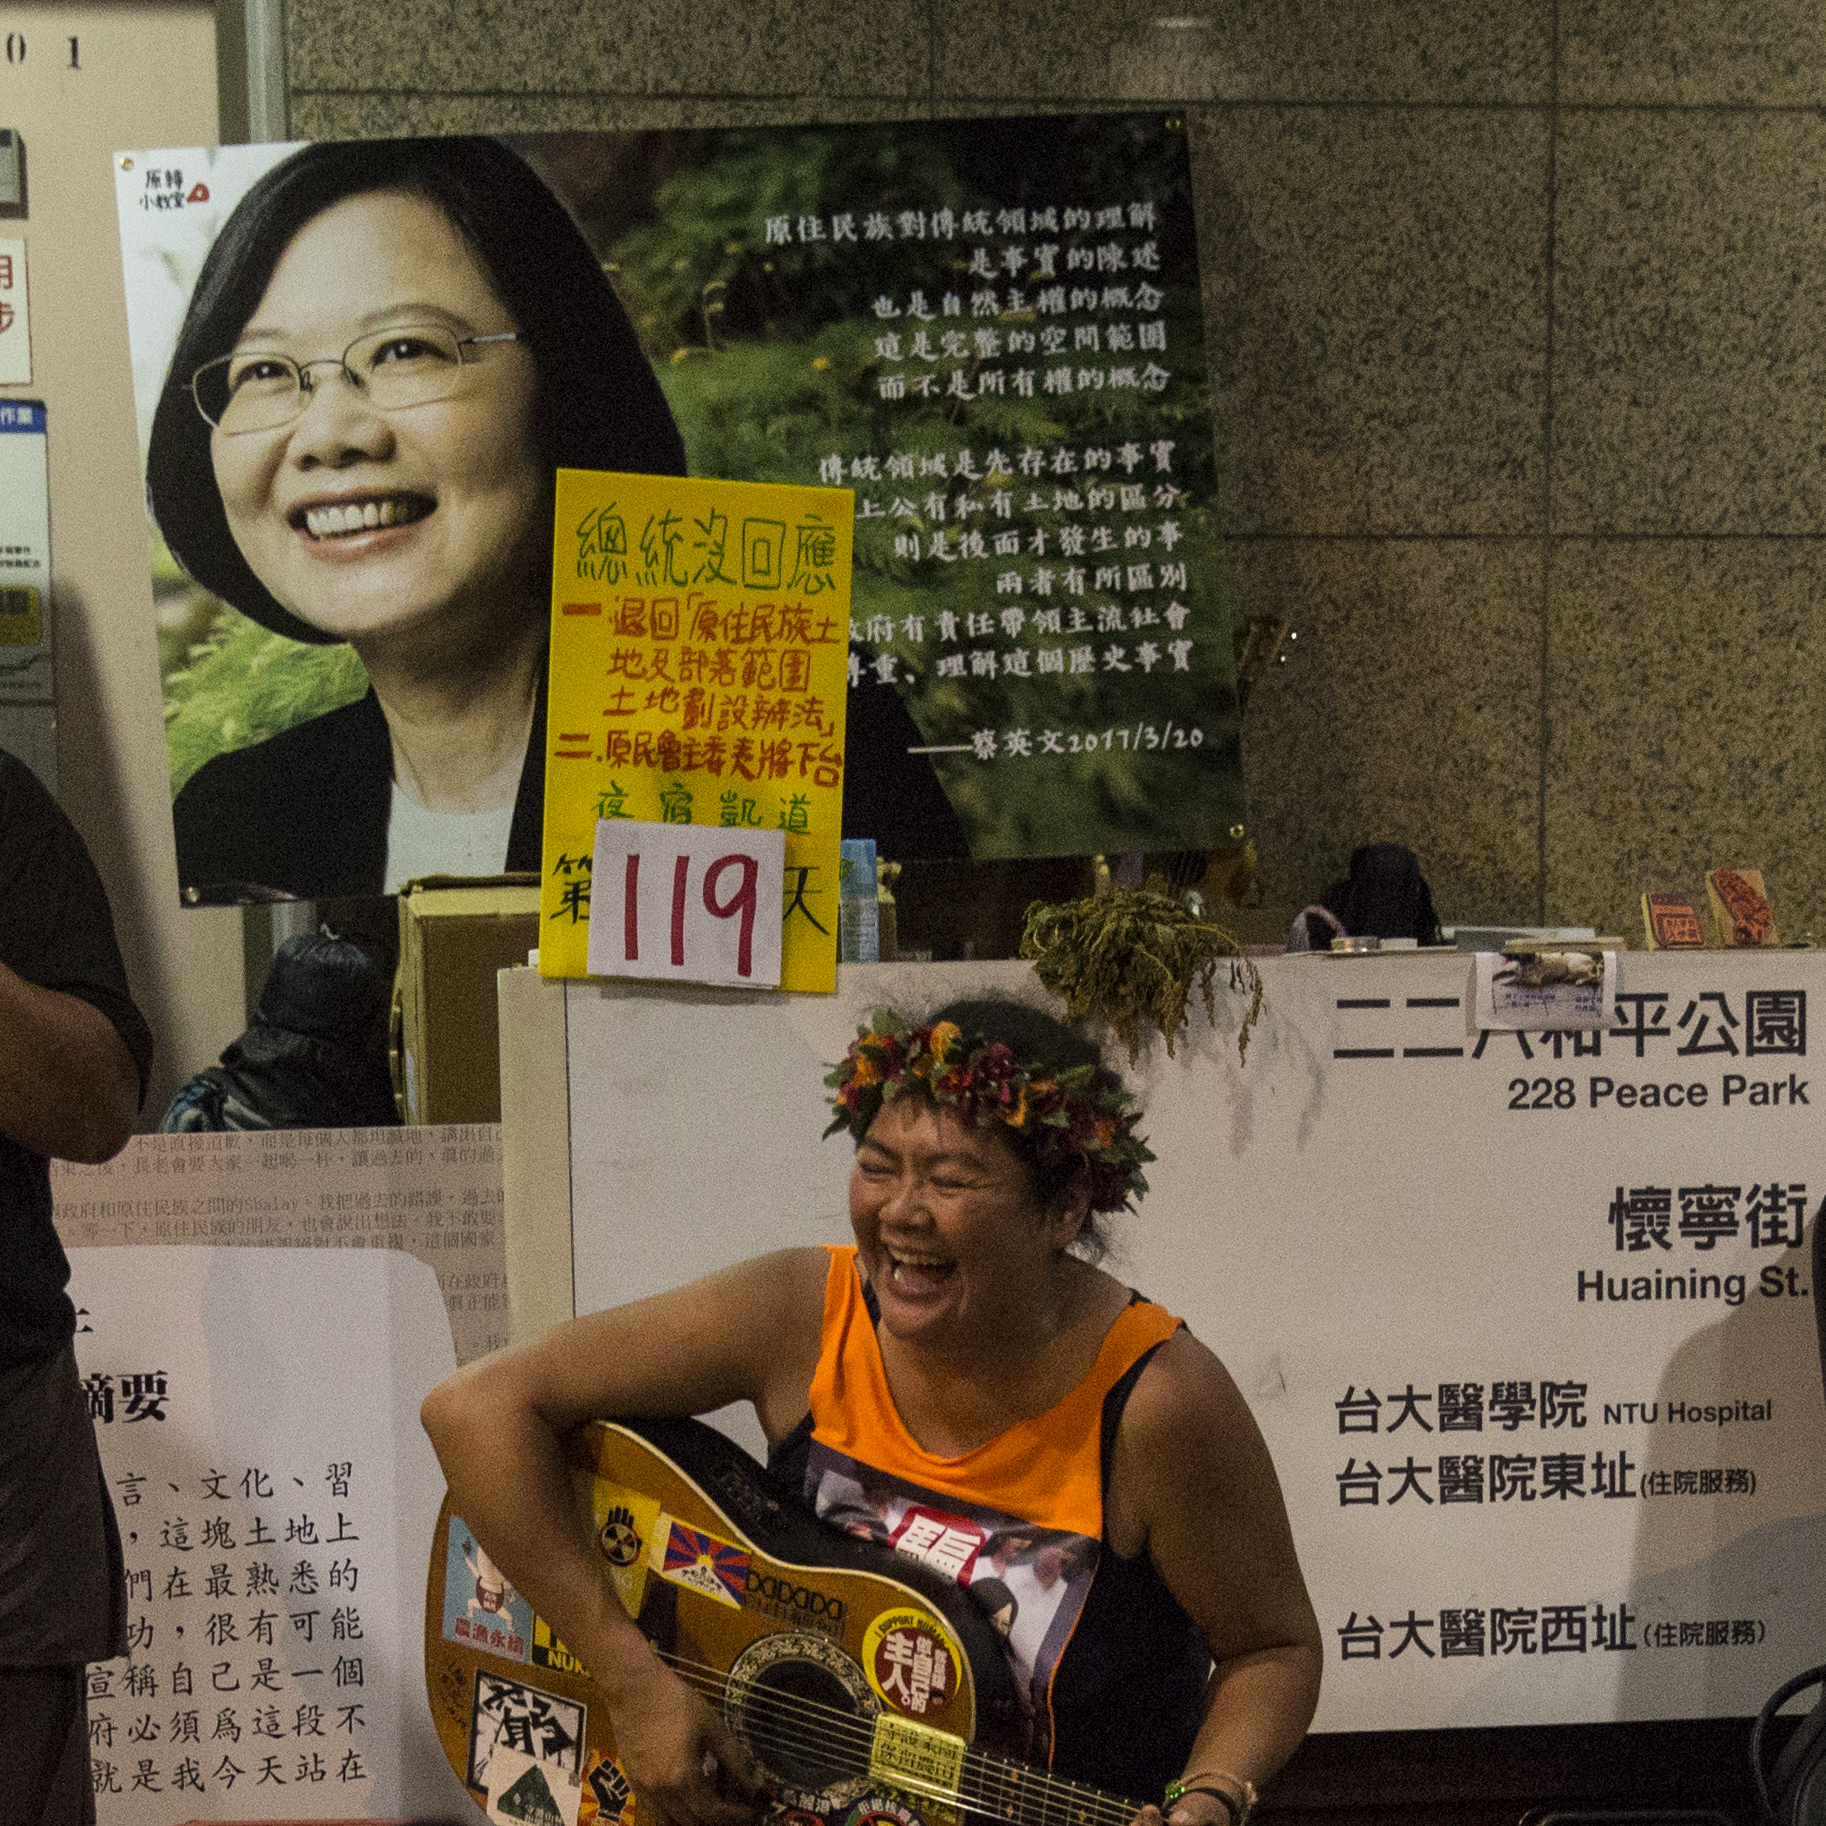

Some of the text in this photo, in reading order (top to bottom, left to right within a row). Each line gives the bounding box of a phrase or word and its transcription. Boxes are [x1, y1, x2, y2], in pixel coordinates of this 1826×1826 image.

[765, 201, 1158, 245] 原住民族對傳統領域的理解
[970, 241, 1161, 280] 是事實的陳述
[873, 281, 1165, 322] 也是自然主權的概念
[874, 319, 1168, 362] 這是完整的空間範圍
[877, 361, 1171, 401] 而不是所有權的概念
[819, 440, 1176, 486] 傳統領域是先存在的事實
[894, 519, 1184, 563] 則是後面才發生的事
[995, 561, 1188, 597] 兩者有所區別
[606, 648, 812, 693] 地及部落範圍
[624, 852, 759, 978] 119
[1507, 1073, 1810, 1111] 228 Peace Park
[1608, 1182, 1808, 1253] 懷寧街
[1575, 1265, 1810, 1306] Huaining St.
[1333, 1379, 1773, 1436] 台大醫學院 NTU Hospital
[116, 1460, 354, 1508] 言、文化、習
[128, 1512, 360, 1551] ，這塊土地上
[122, 1557, 359, 1604] 們在最熟悉的
[126, 1606, 364, 1651] 功，很有可能
[86, 1654, 365, 1702] 宣稱自己是一個
[89, 1748, 368, 1795] 就是我今天站在
